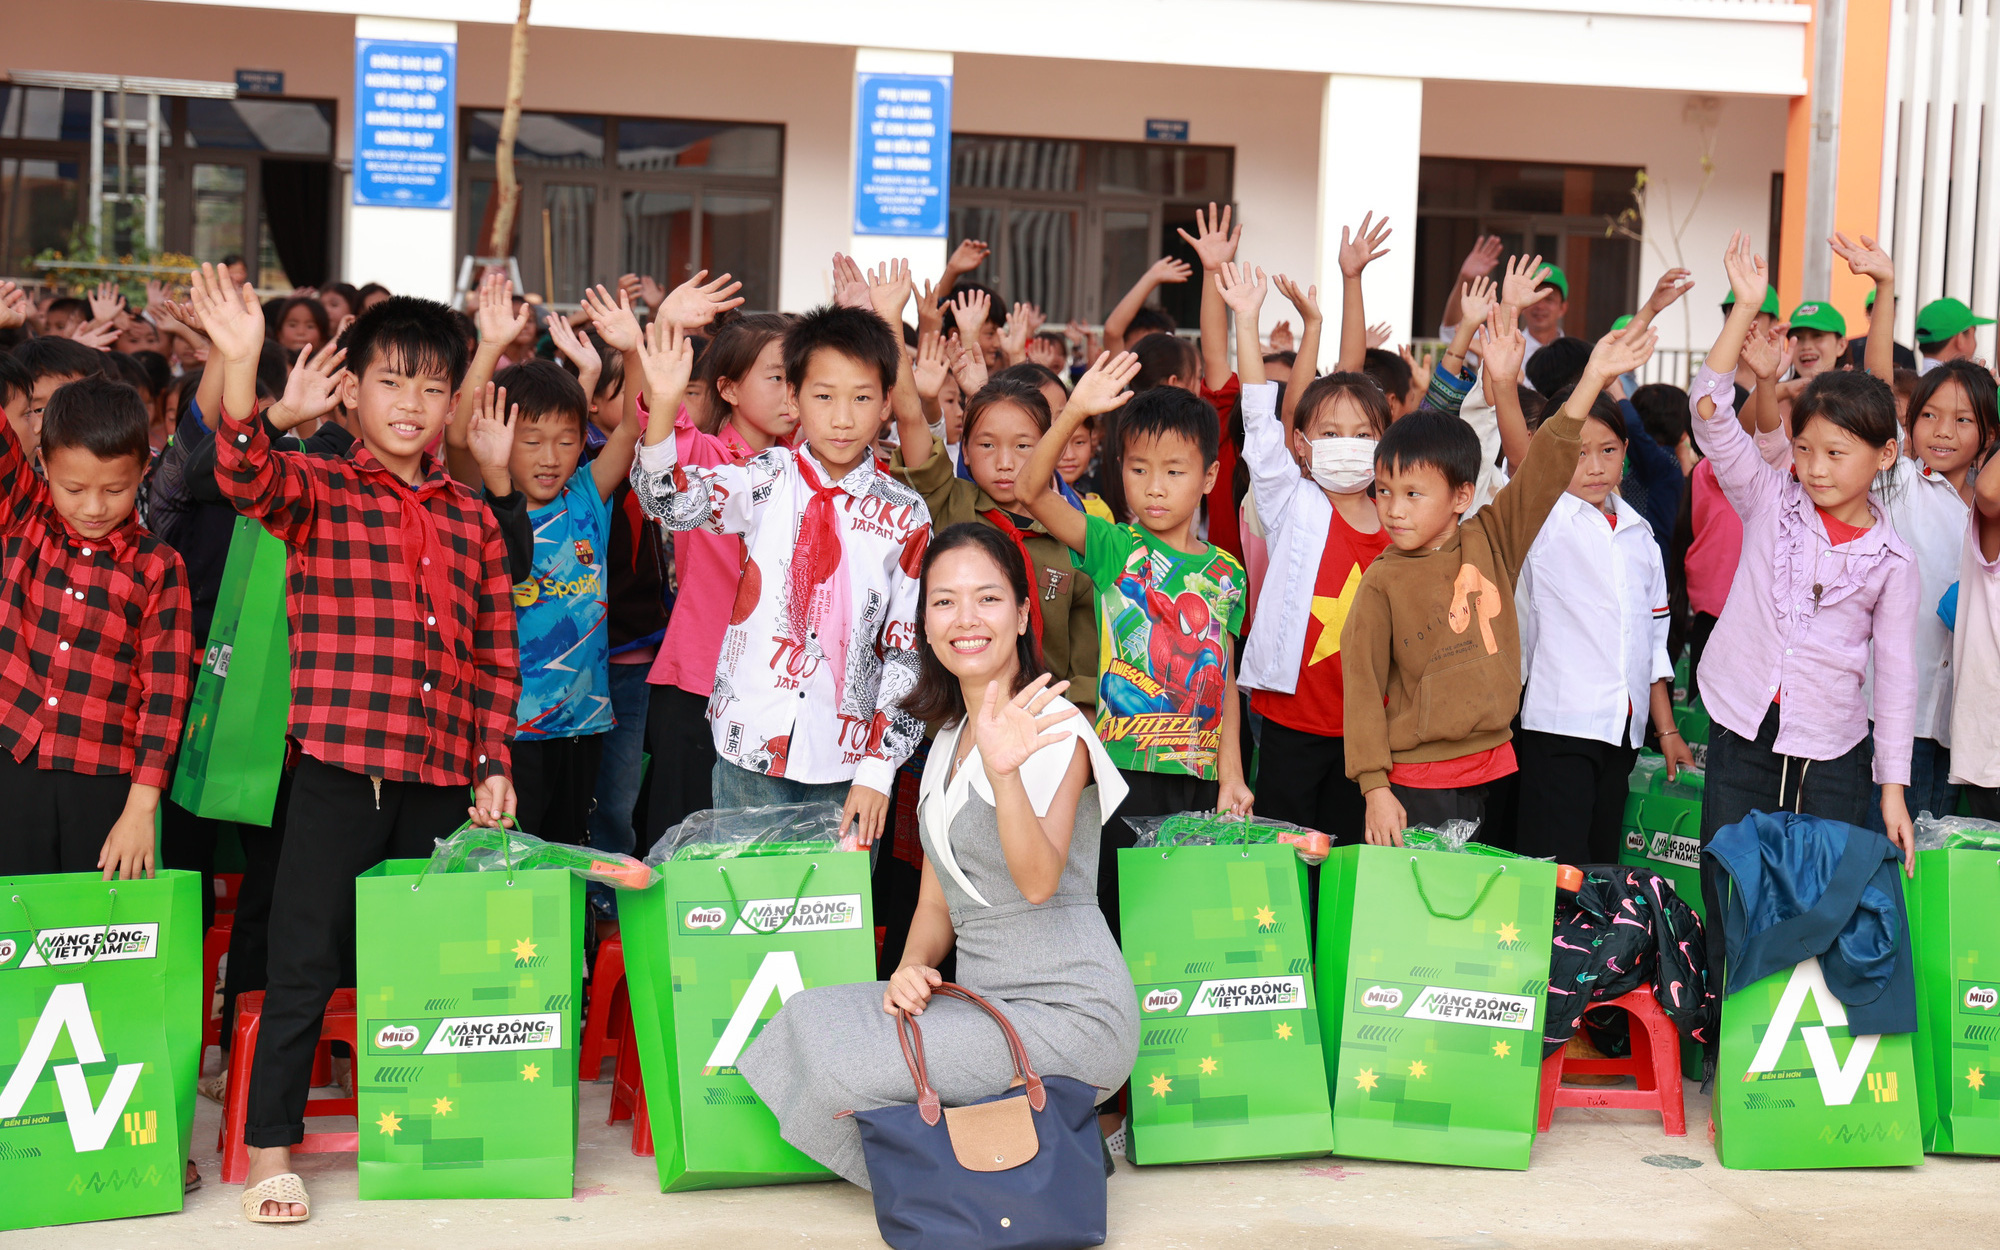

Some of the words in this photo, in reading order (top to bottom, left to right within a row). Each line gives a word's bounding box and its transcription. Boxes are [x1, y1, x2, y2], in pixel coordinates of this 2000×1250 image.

[851, 517, 894, 540] JAPAN
[543, 574, 601, 598] Spotify
[864, 592, 879, 620] 東京
[1109, 659, 1166, 698] AWESOME!
[727, 725, 741, 753] 東京
[1675, 851, 1692, 862] NAM
[691, 913, 721, 923] MILO
[792, 914, 828, 926] NAM
[37, 932, 93, 953] NĂNG
[44, 942, 81, 959] VIỆT
[84, 943, 123, 955] NAM
[1149, 995, 1177, 1006] MILO
[1201, 984, 1247, 1003] NĂNG
[1208, 993, 1241, 1009] VIỆT
[1245, 994, 1277, 1006] NAM
[1368, 992, 1398, 1004] MILO
[1421, 992, 1471, 1007] NĂNG
[1970, 993, 1993, 1003] MILO
[1428, 1003, 1464, 1017] VIỆT
[1466, 1008, 1502, 1021] NAM
[382, 1032, 414, 1042] MILO
[440, 1021, 493, 1042] NĂNG
[449, 1031, 485, 1048] VIỆT
[489, 1033, 526, 1045] NAM
